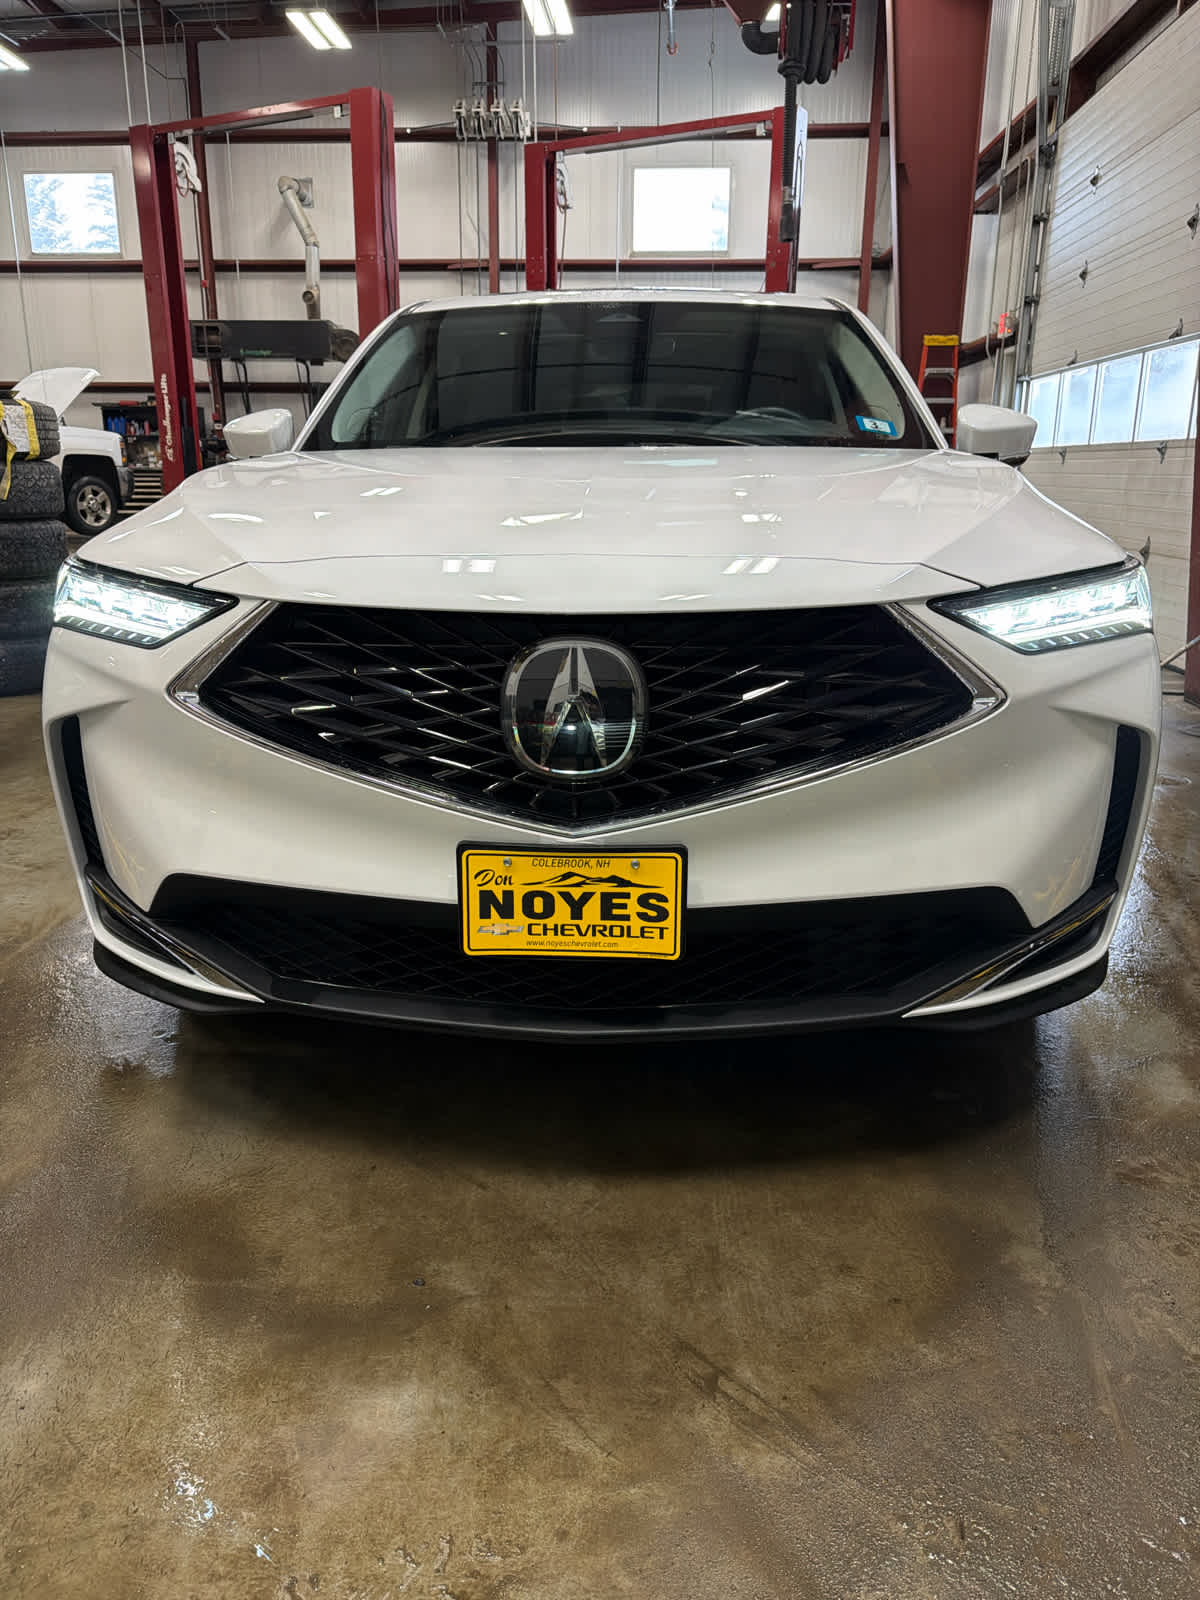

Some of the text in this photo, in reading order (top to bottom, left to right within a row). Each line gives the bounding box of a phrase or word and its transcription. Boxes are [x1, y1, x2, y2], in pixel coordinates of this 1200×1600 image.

[531, 857, 611, 870] COLEBROOK, NH
[473, 869, 514, 887] Don
[478, 889, 670, 923] NOYES
[527, 922, 670, 940] CHEVROLET
[526, 939, 619, 948] www.noyeschevrolet.com
